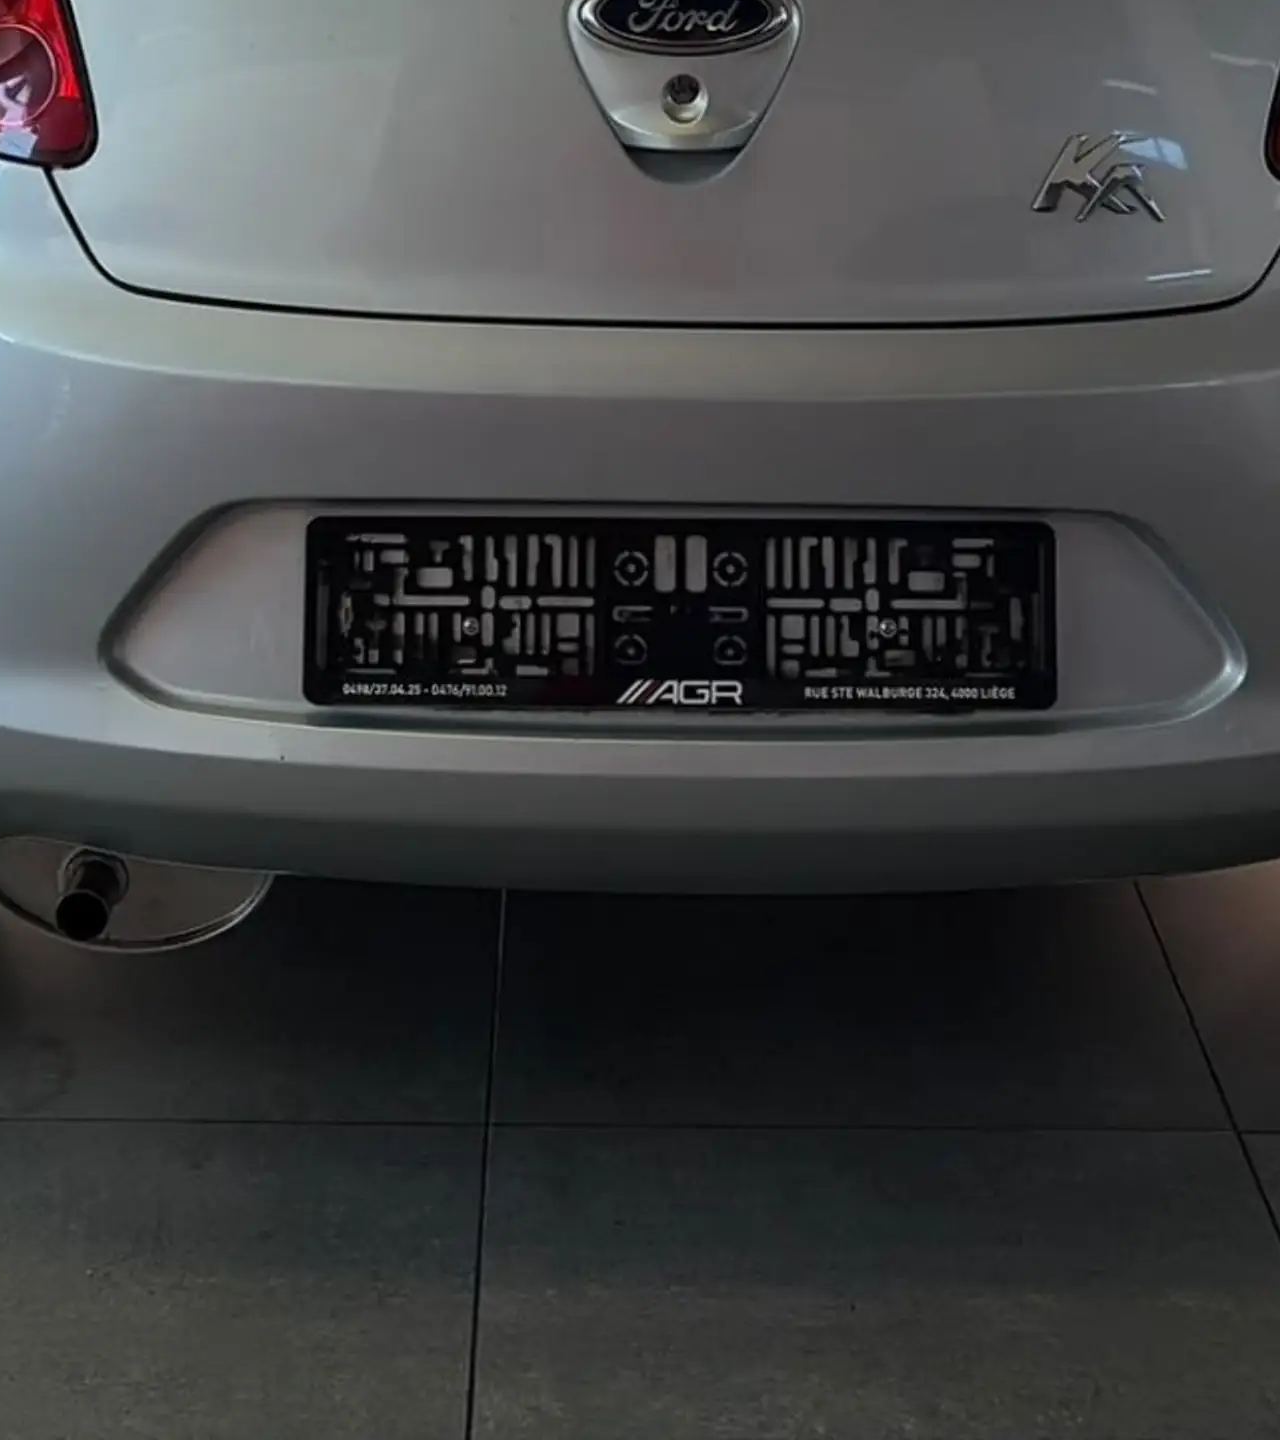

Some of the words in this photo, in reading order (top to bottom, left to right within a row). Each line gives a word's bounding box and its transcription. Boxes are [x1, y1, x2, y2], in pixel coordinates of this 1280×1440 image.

[803, 686, 830, 700] RUE
[831, 686, 854, 700] STE
[856, 686, 922, 700] WALBURGE
